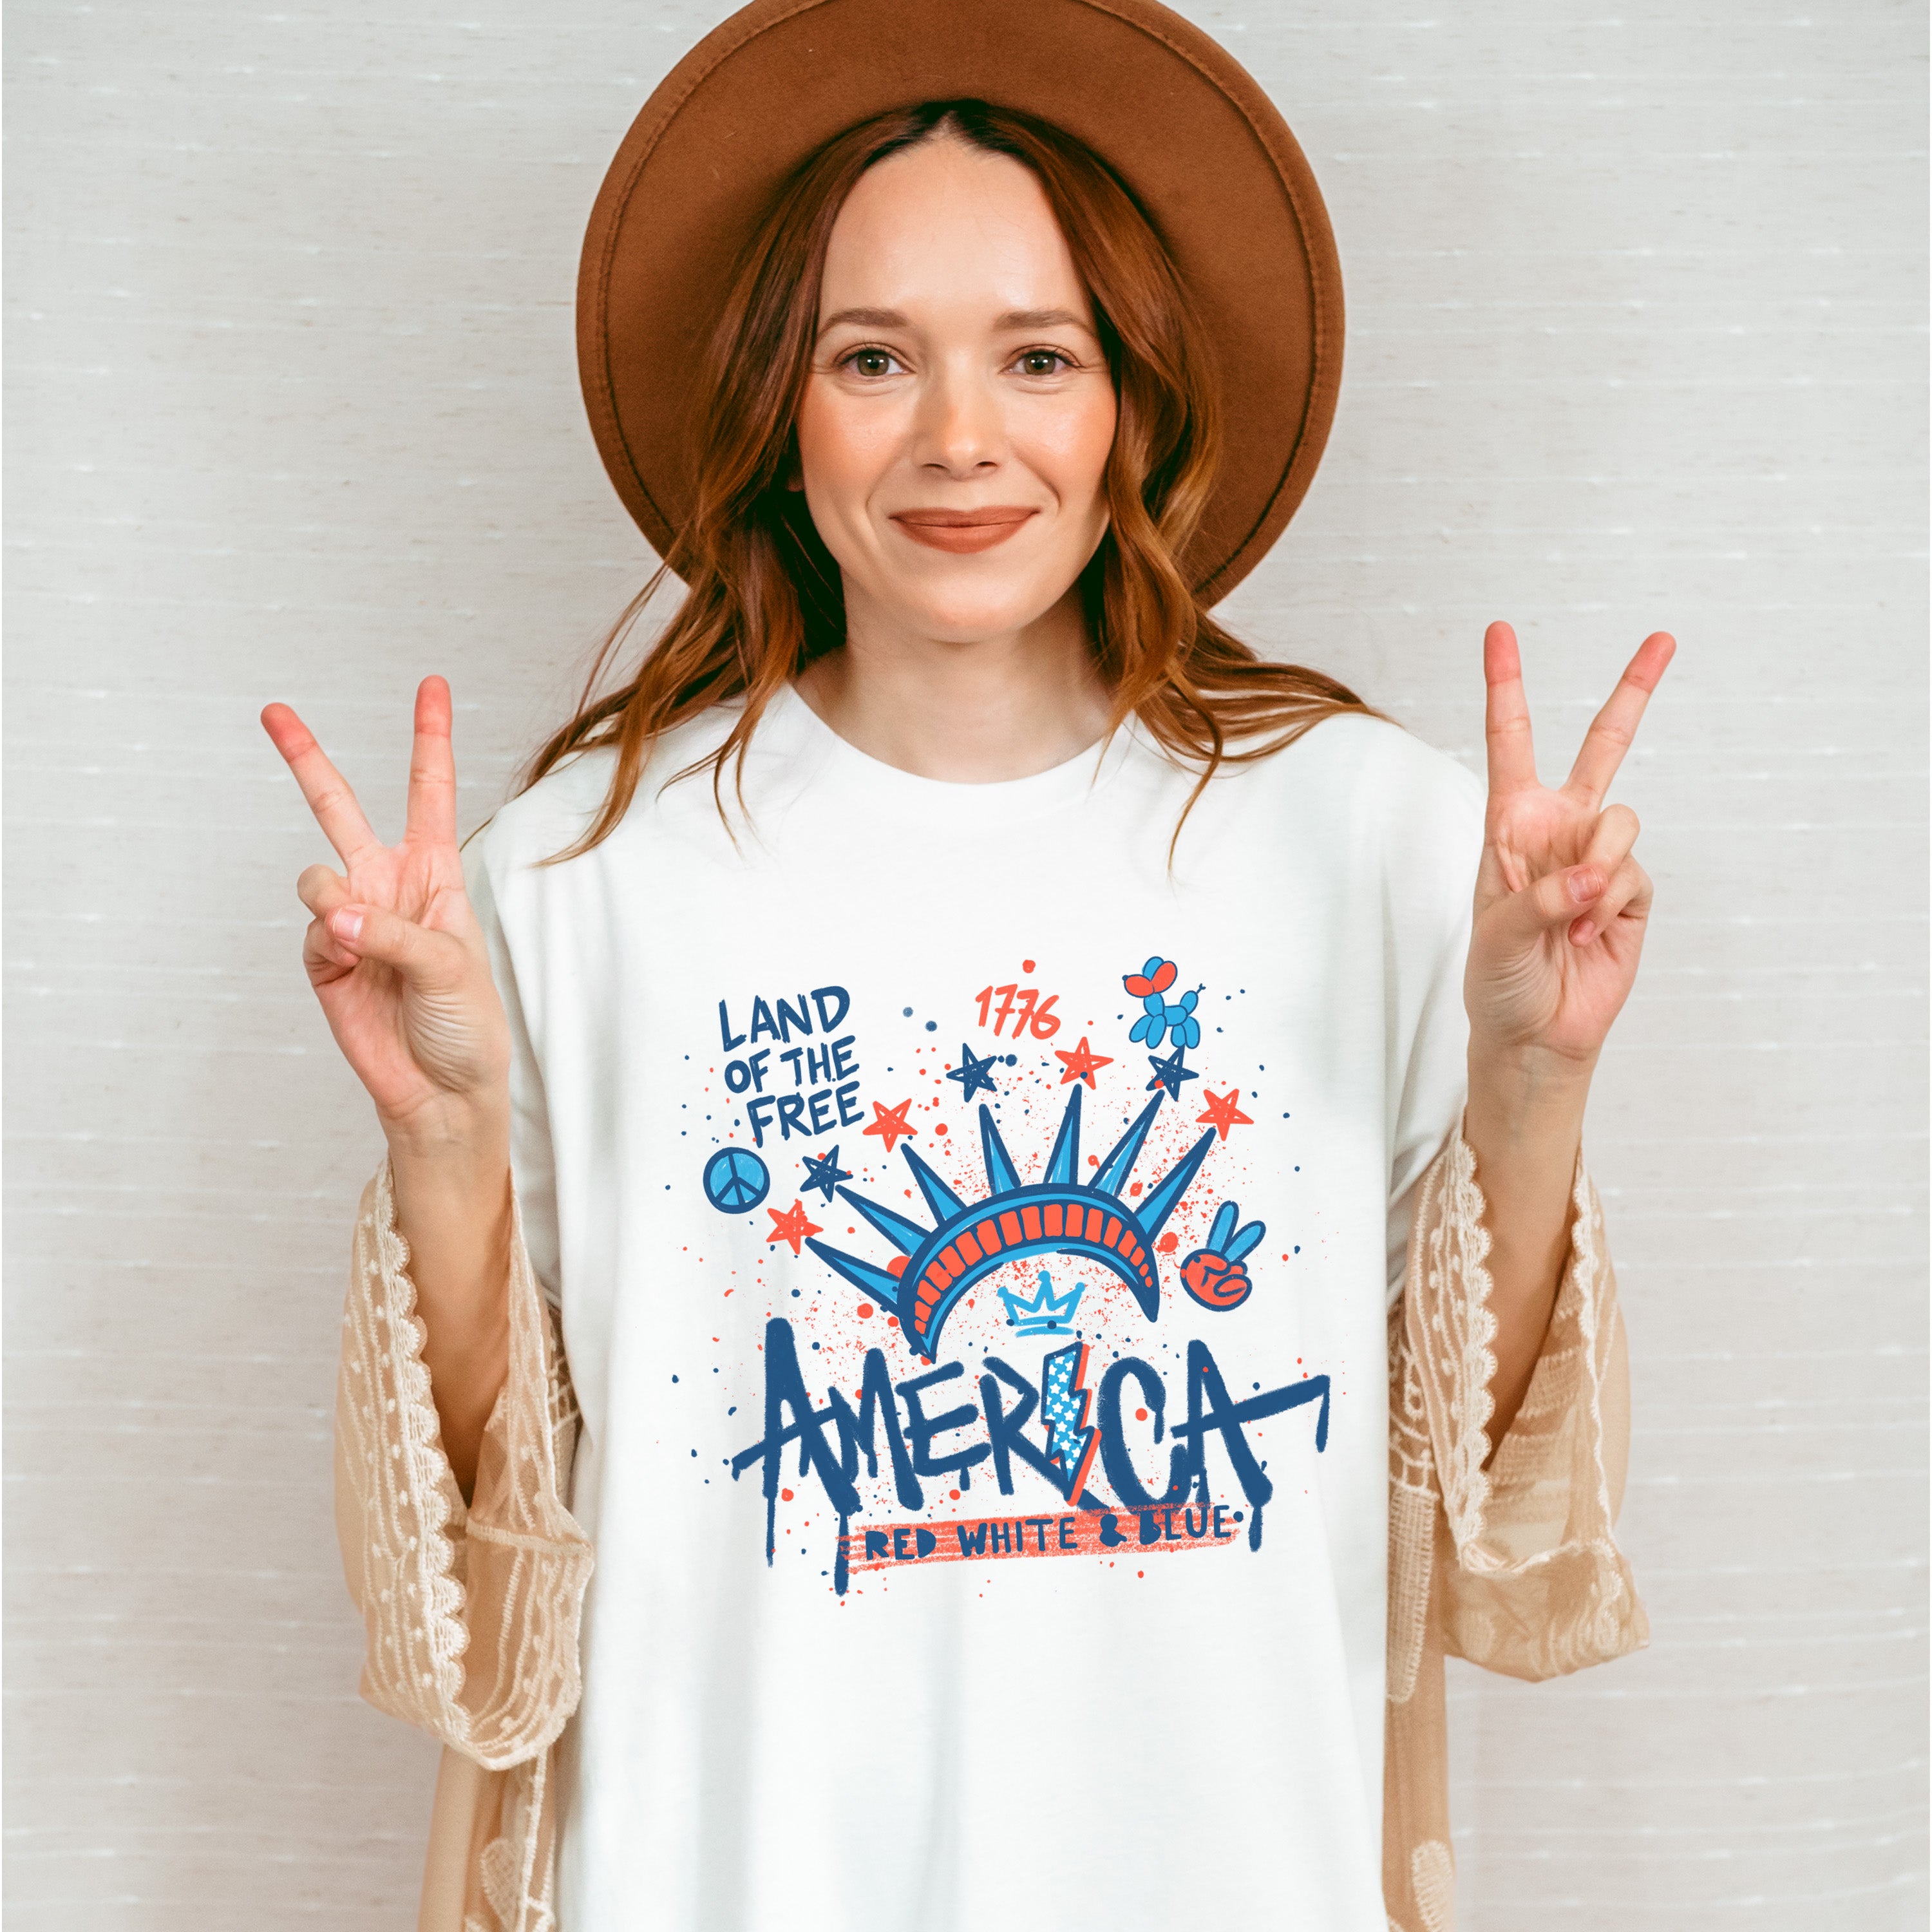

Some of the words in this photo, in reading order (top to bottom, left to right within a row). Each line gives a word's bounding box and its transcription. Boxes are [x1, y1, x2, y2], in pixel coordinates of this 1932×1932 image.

[719, 986, 850, 1052] LAND
[975, 983, 1061, 1039] 1776
[724, 1048, 770, 1094] OF
[781, 1035, 860, 1086] THE
[747, 1081, 864, 1148] FREE
[732, 1318, 1331, 1595] AMERICA
[866, 1528, 936, 1560] RED
[958, 1515, 1077, 1557] WHITE
[1100, 1513, 1127, 1546] &
[1139, 1505, 1232, 1545] BLUE
